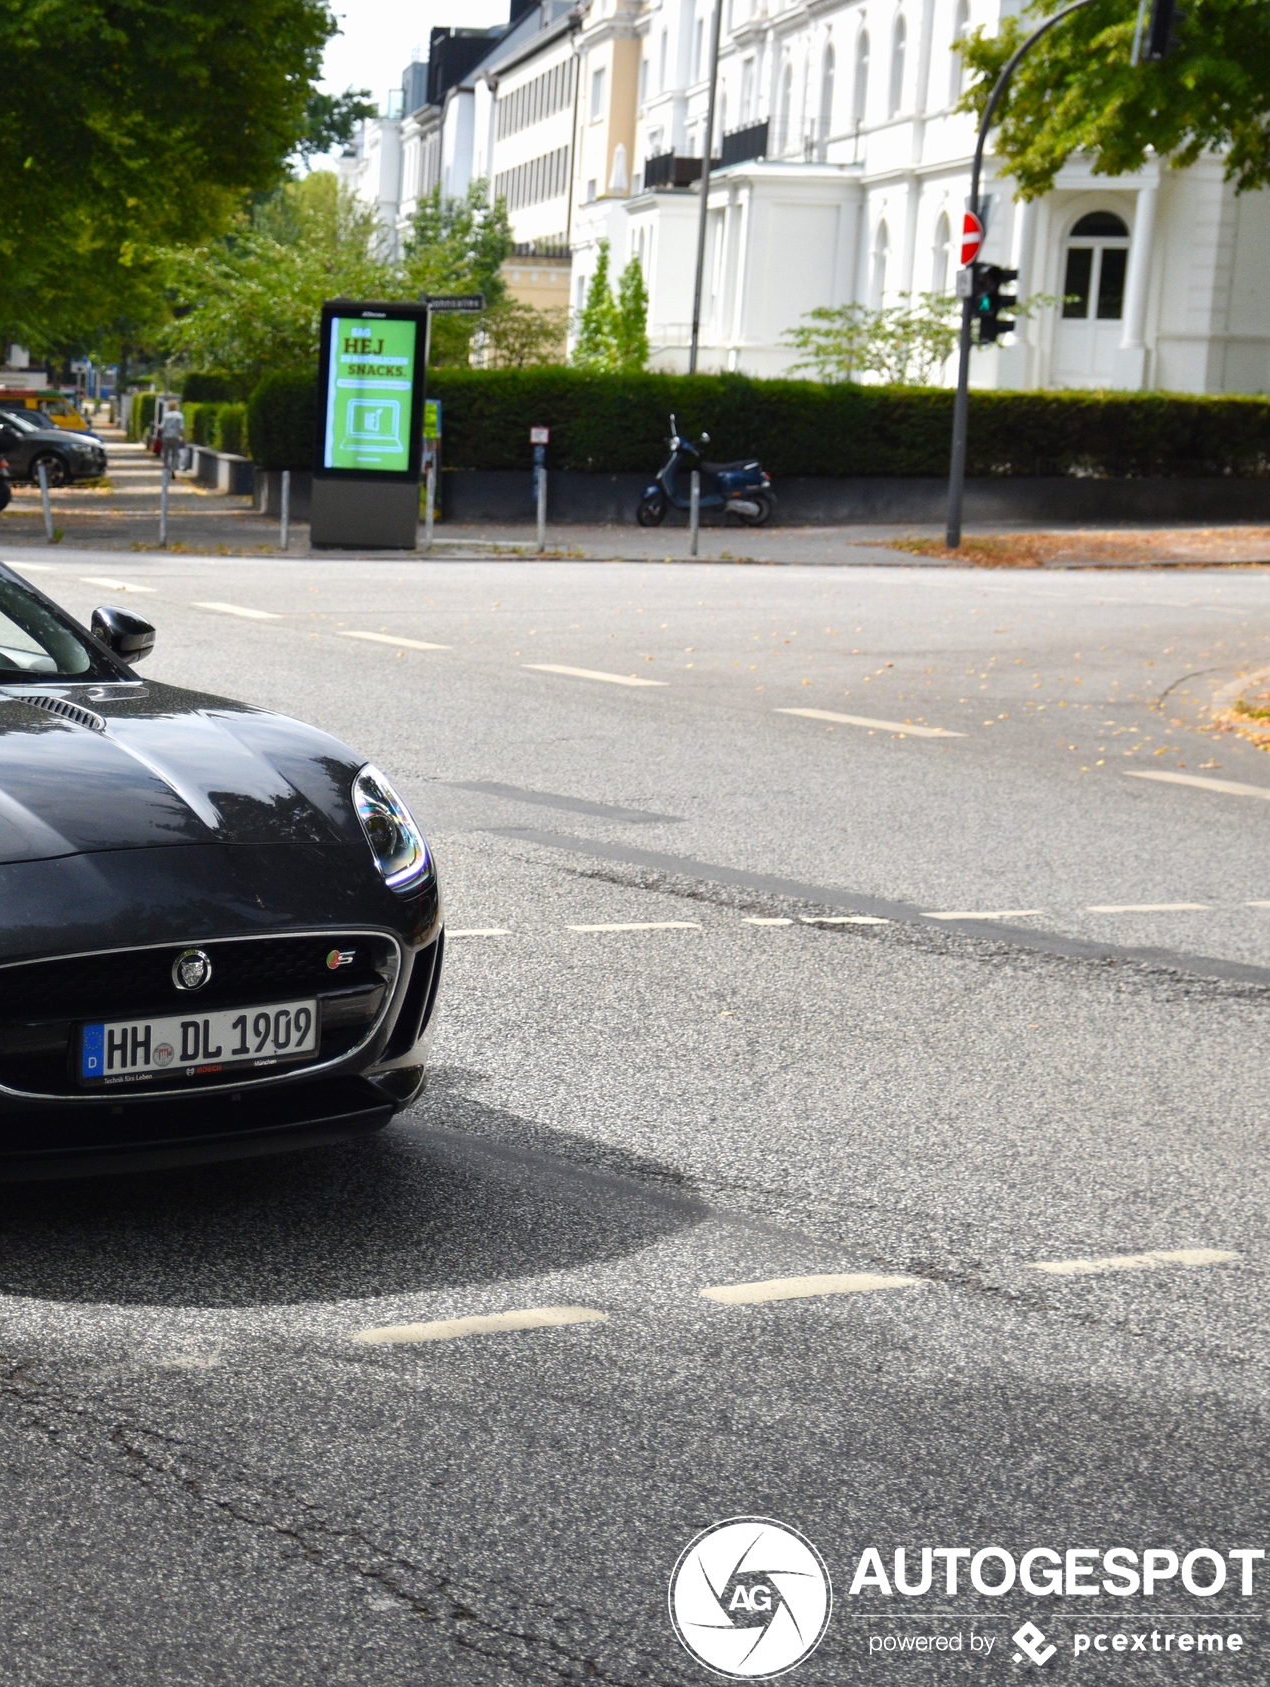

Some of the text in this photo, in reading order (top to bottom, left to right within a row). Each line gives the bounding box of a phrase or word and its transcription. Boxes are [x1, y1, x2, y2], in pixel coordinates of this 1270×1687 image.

[343, 337, 384, 354] HEJ
[336, 951, 356, 965] S
[107, 1024, 152, 1070] HH
[180, 1019, 223, 1061] DL
[231, 1007, 312, 1056] 1909
[88, 1057, 97, 1069] D
[197, 1064, 222, 1074] BOSCH
[253, 1059, 277, 1067] München
